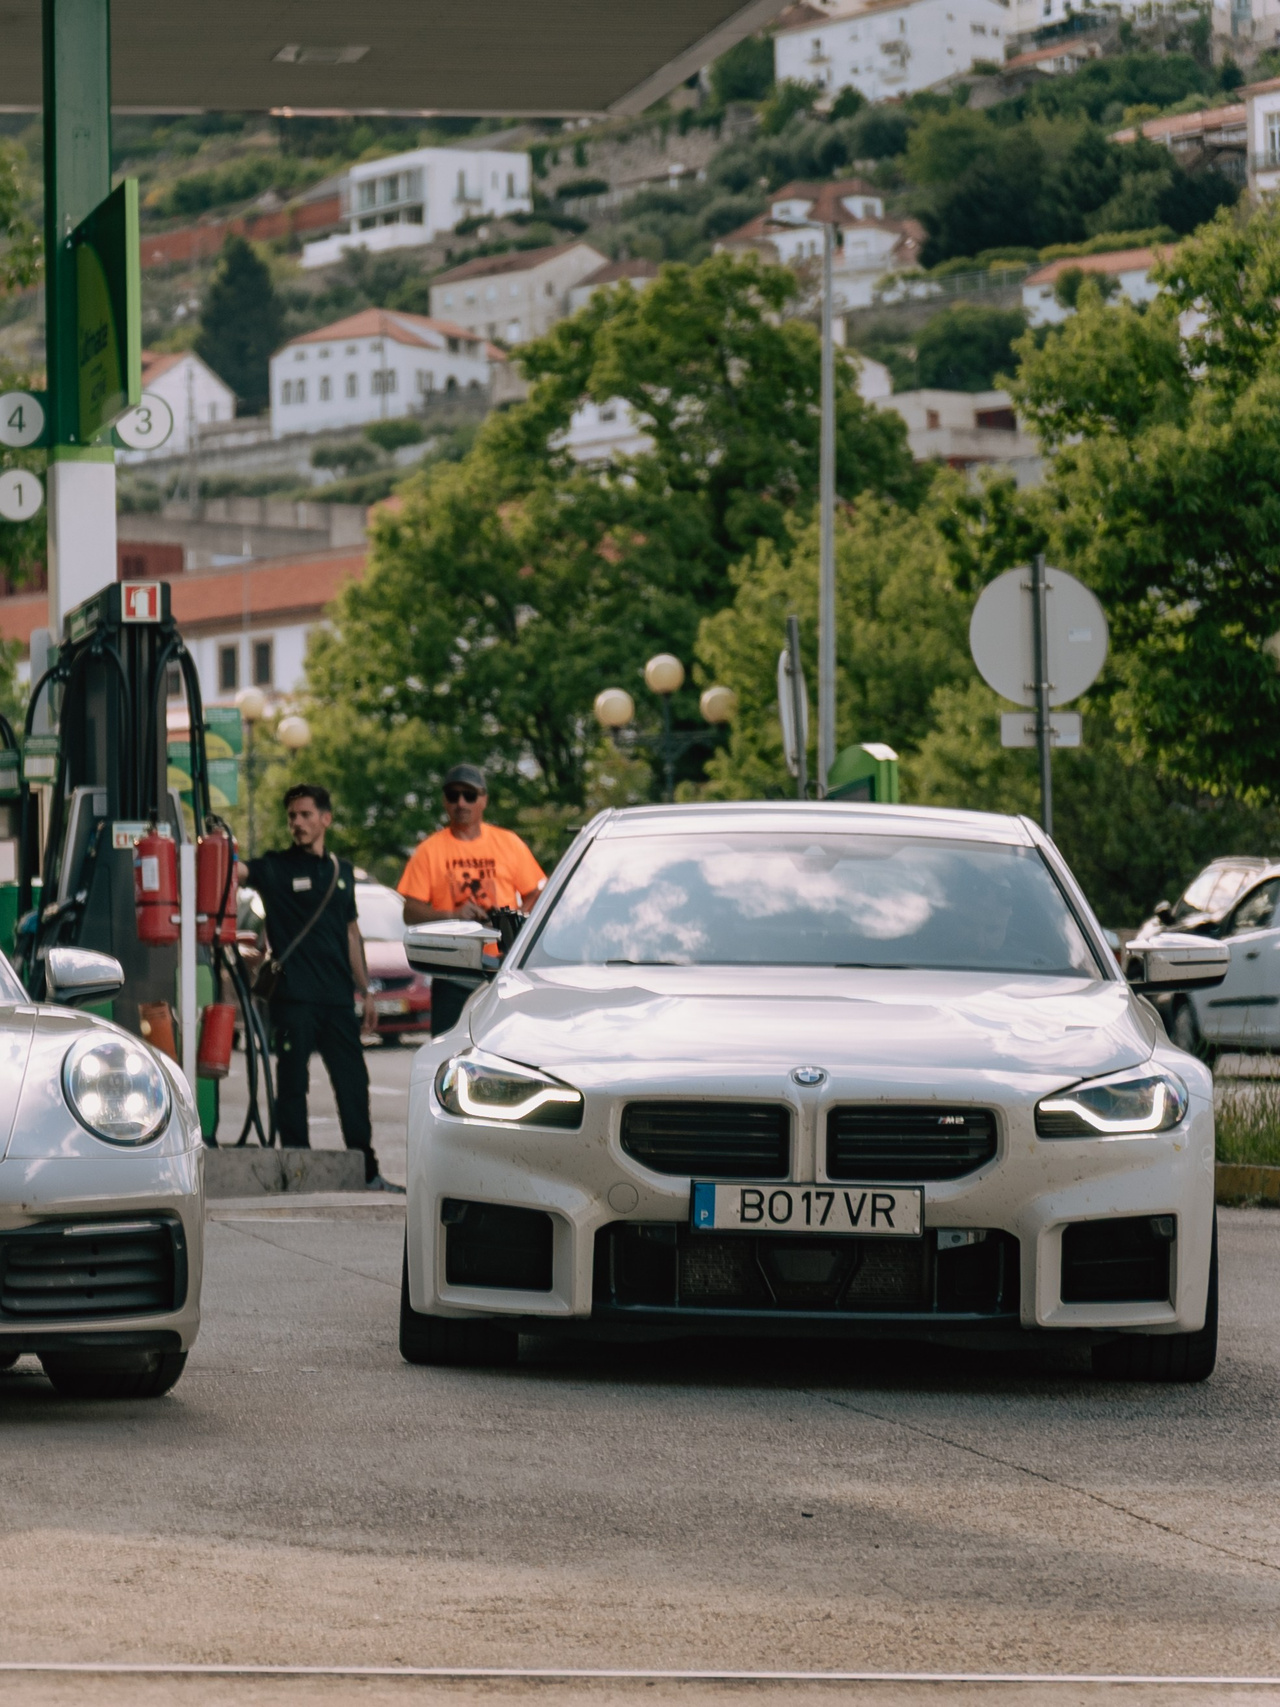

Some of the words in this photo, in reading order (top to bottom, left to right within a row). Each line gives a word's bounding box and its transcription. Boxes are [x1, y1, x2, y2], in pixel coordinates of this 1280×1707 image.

[7, 403, 26, 433] 4
[135, 408, 152, 435] 3
[13, 484, 23, 507] 1
